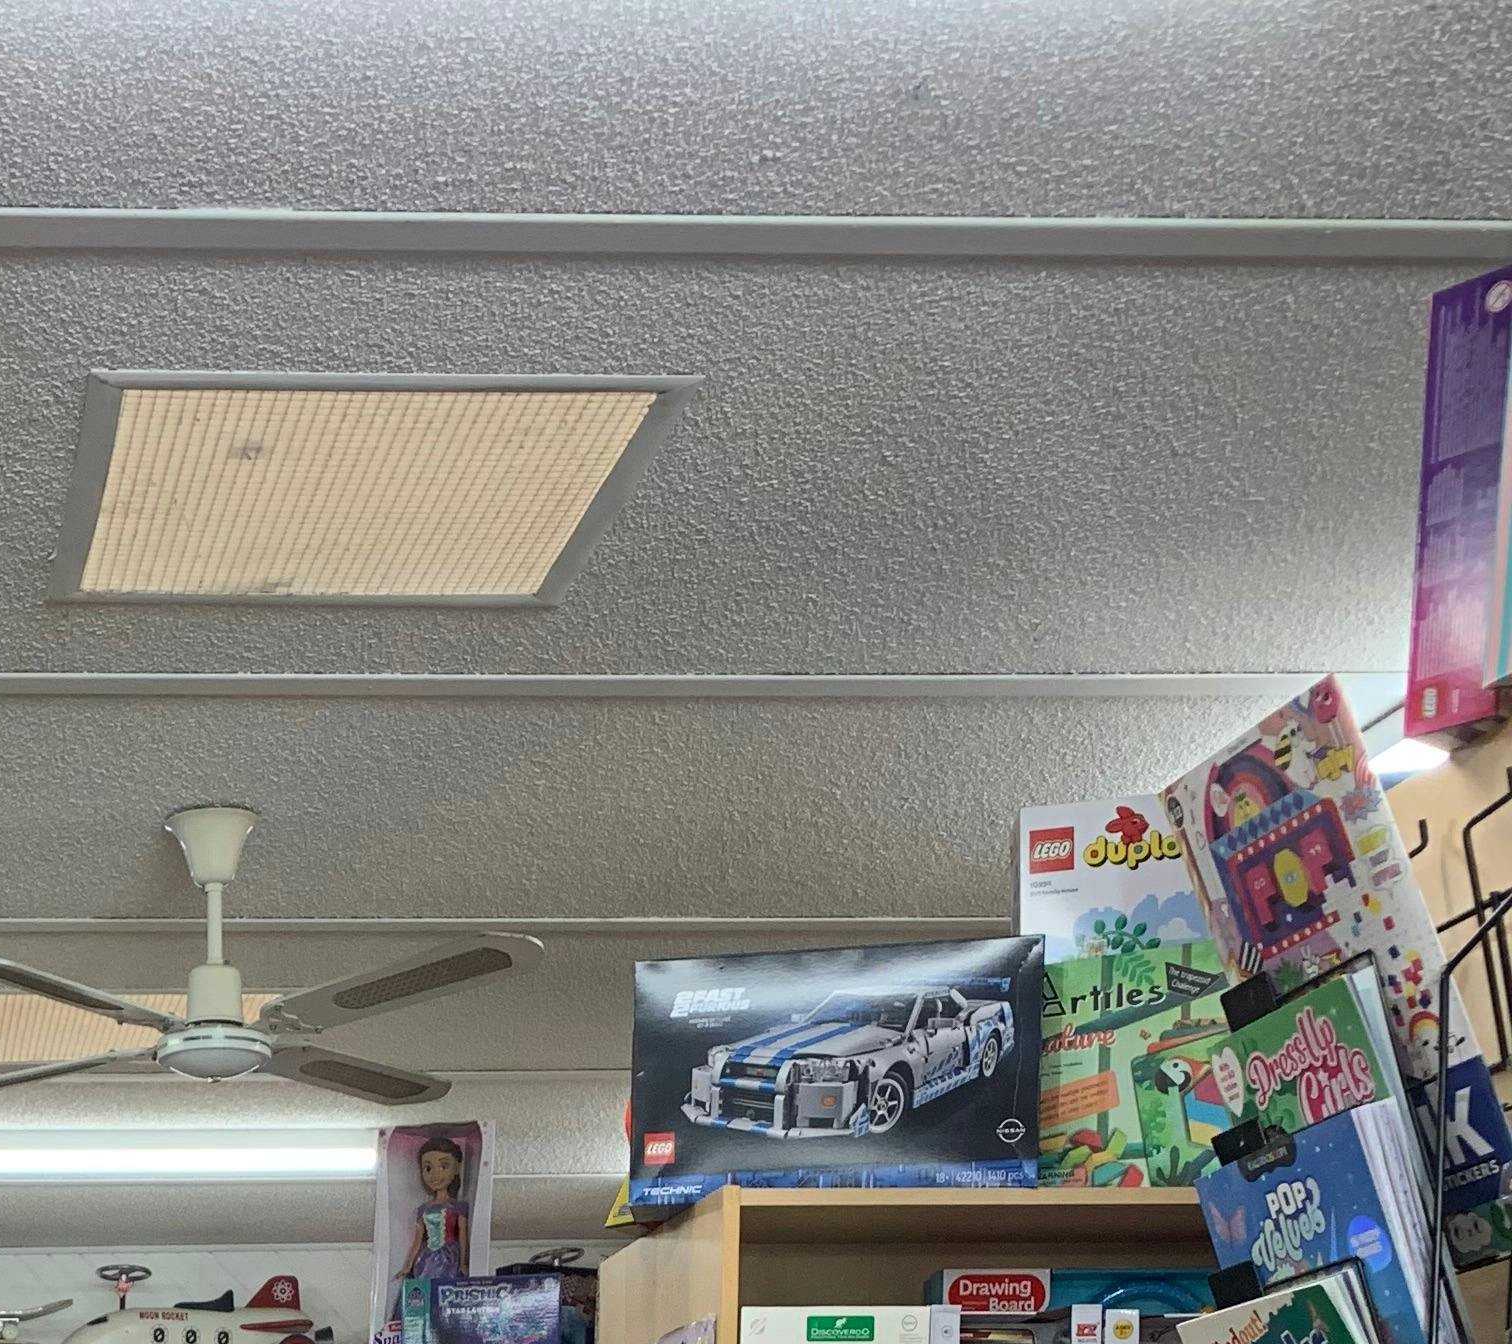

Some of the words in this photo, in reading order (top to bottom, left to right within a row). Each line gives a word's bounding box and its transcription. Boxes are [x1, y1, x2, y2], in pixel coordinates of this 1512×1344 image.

[1033, 840, 1072, 860] LEGO
[1084, 830, 1183, 870] duplo
[646, 1141, 673, 1155] LEGO
[643, 1186, 702, 1196] TECHNIC
[959, 1279, 1031, 1297] Drawing
[989, 1297, 1034, 1312] Board
